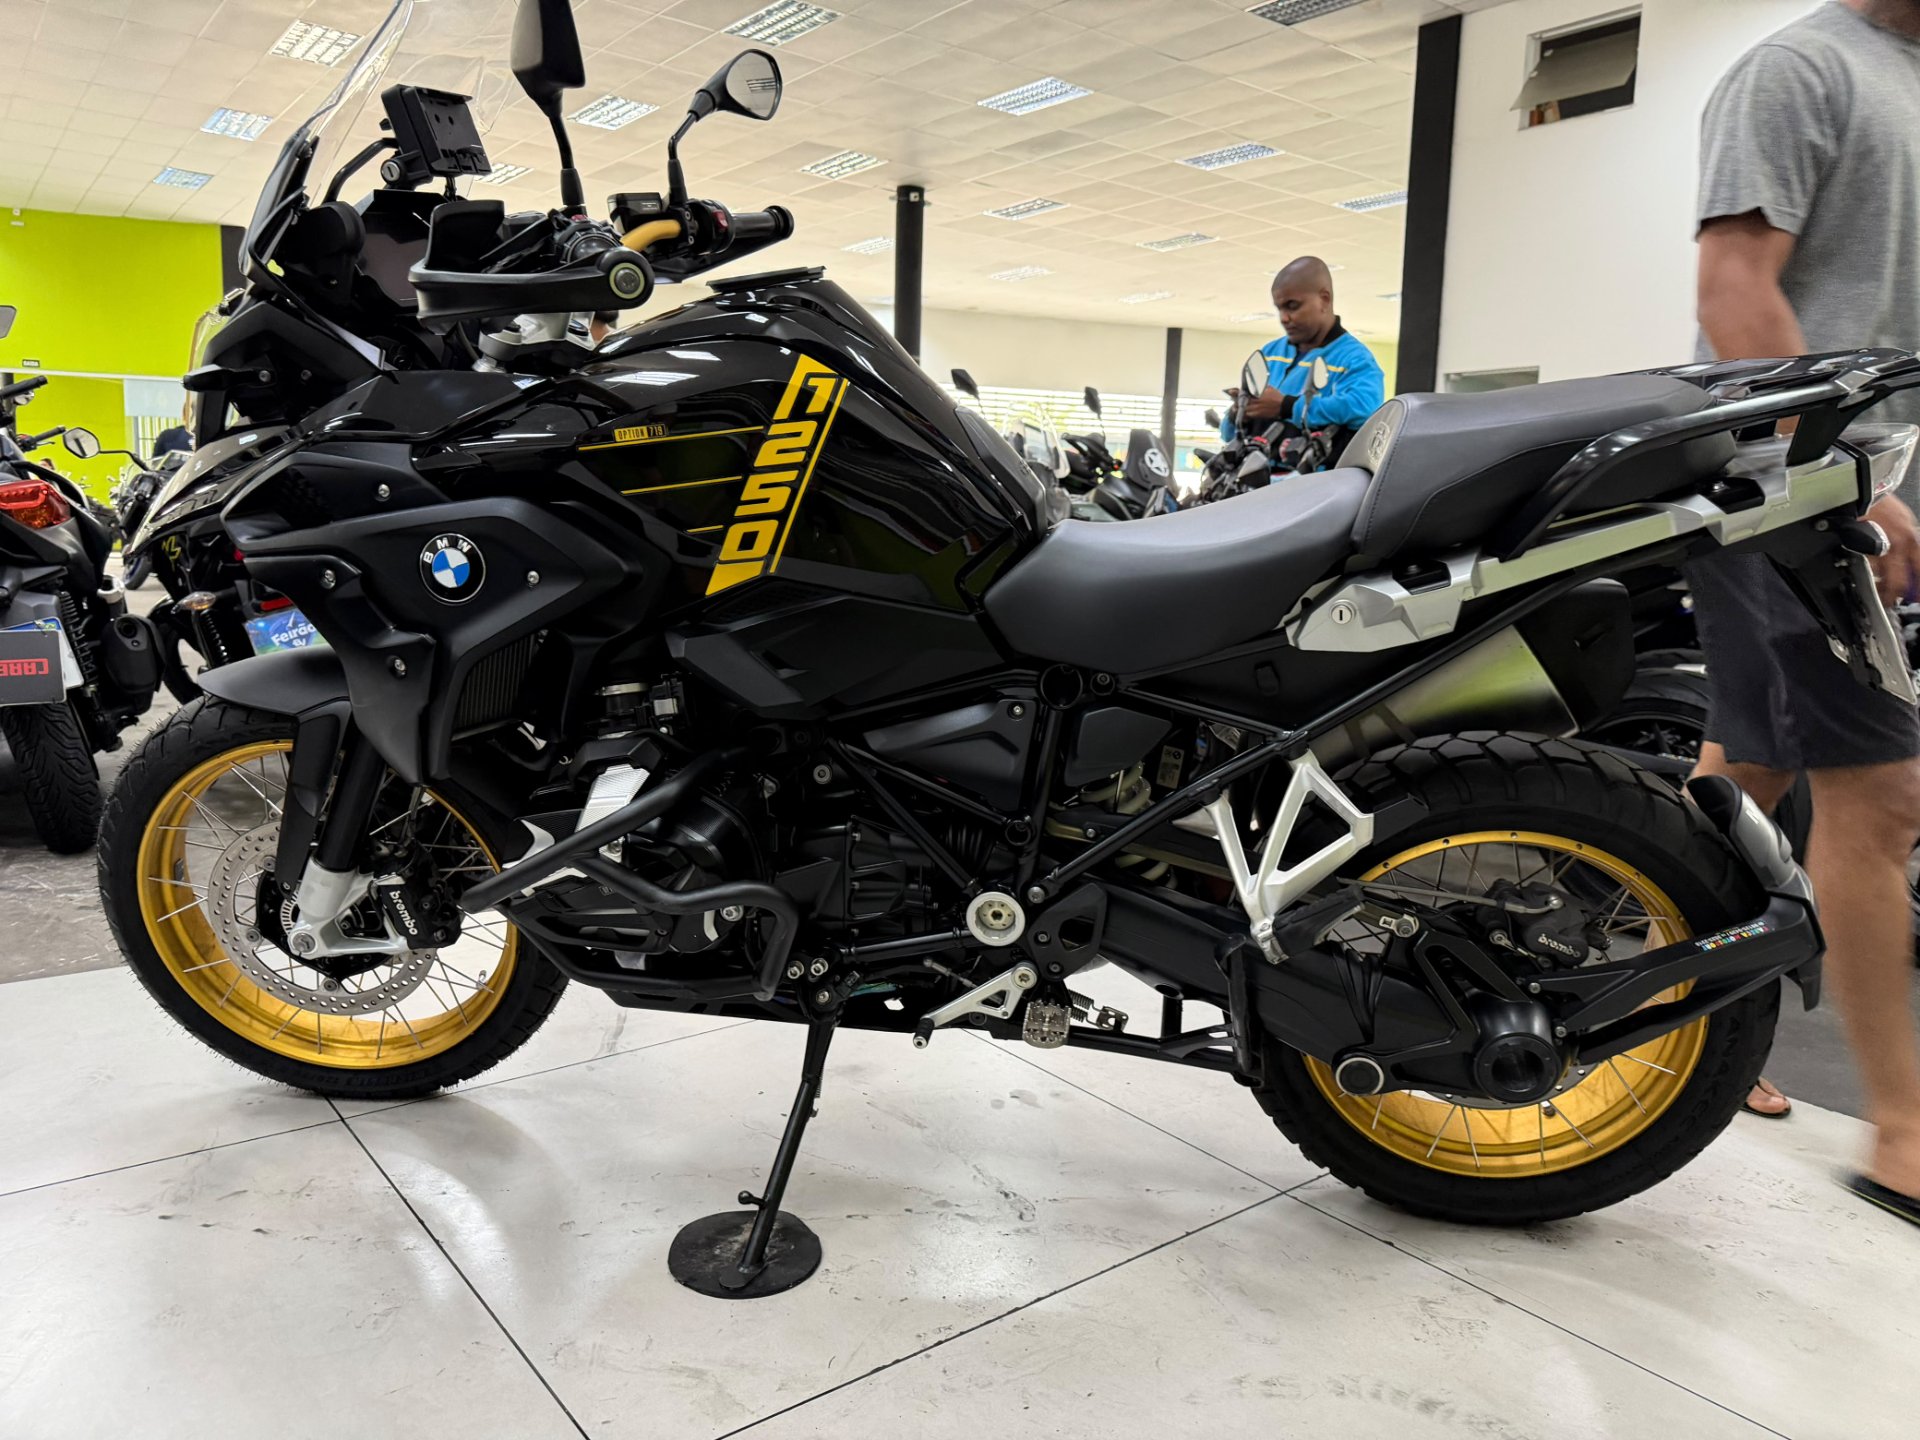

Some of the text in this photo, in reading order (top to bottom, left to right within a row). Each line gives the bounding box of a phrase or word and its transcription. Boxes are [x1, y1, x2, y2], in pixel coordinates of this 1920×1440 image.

[617, 424, 664, 441] OPTION 719
[718, 377, 837, 562] 1250
[422, 536, 472, 564] BMW
[270, 622, 317, 647] Feirão
[388, 889, 419, 936] brembo
[1537, 932, 1581, 958] brembo
